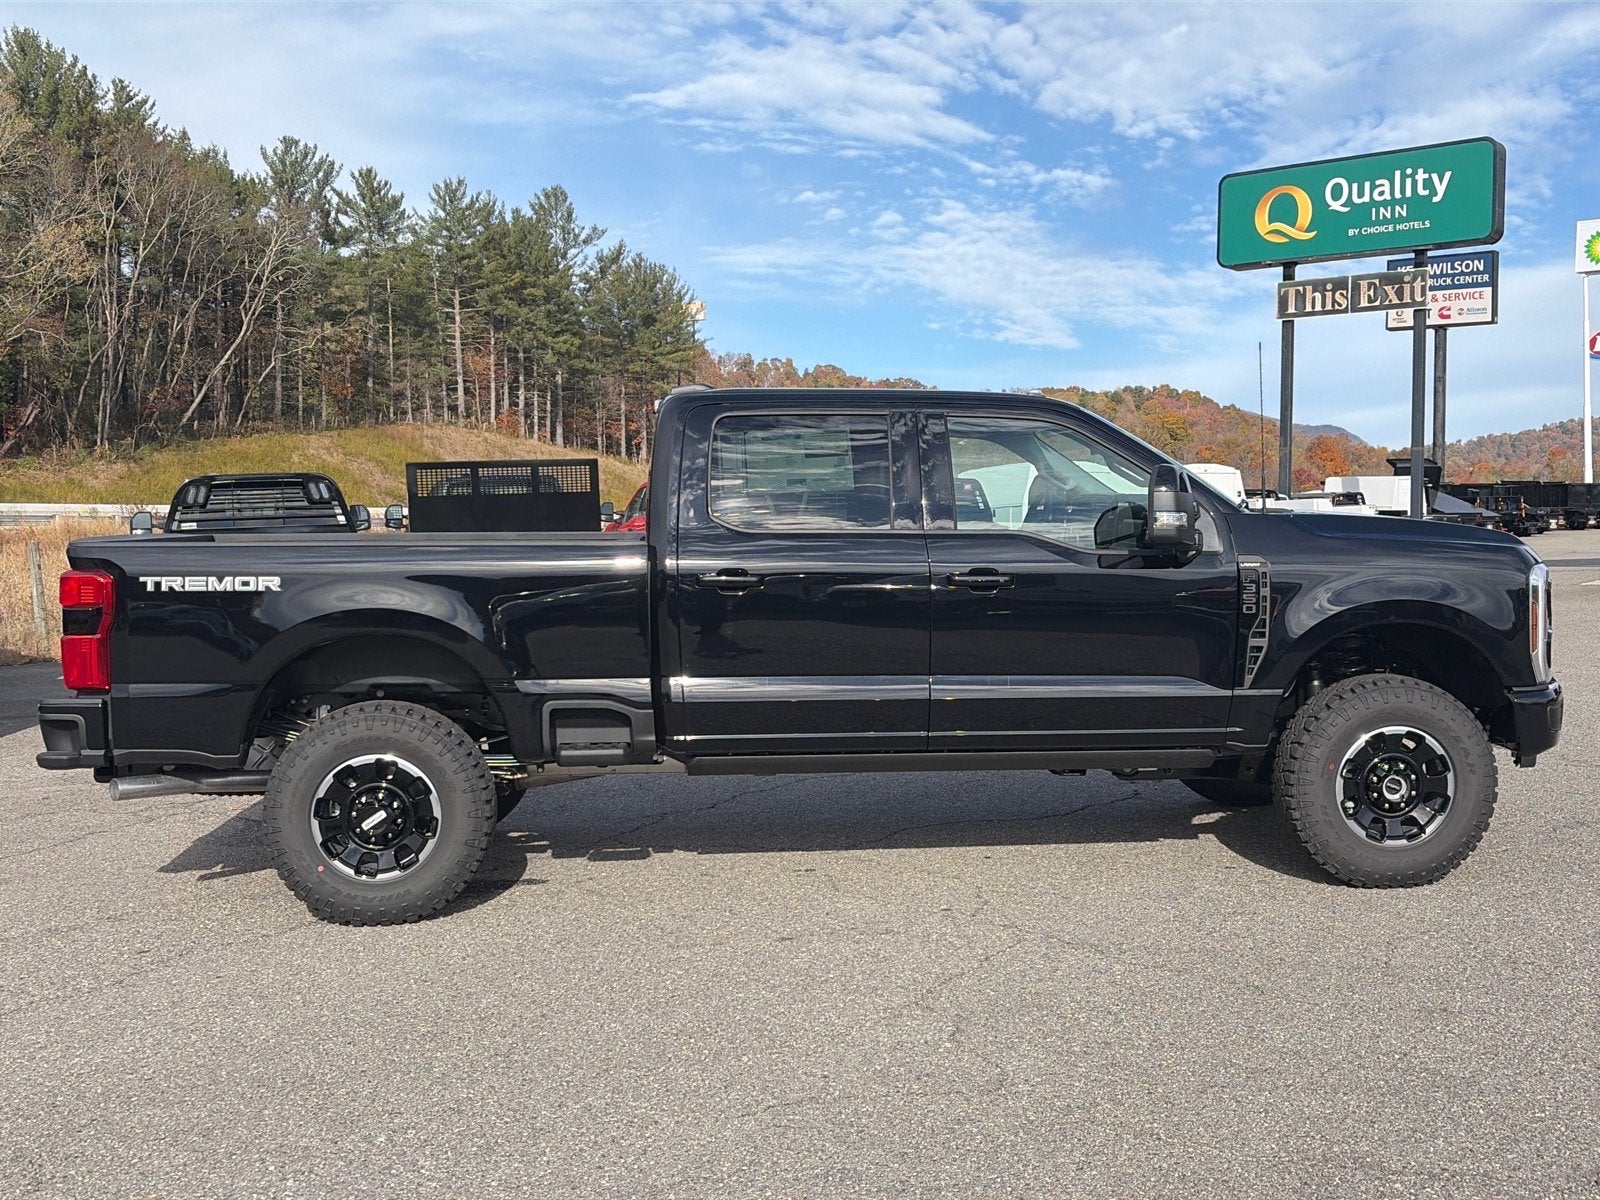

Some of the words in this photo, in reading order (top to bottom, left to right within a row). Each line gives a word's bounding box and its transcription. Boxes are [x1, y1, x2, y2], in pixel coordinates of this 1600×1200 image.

[1325, 168, 1452, 212] Quality
[1371, 204, 1407, 221] INN
[1348, 228, 1360, 236] BY
[1361, 224, 1394, 235] CHOICE
[1396, 220, 1431, 231] HOTELS
[1427, 259, 1484, 275] WILSON
[1428, 277, 1452, 287] RUCK
[1454, 274, 1490, 284] CENTER
[1280, 283, 1348, 314] This
[1357, 275, 1426, 308] Exit
[1430, 293, 1439, 303] &
[1442, 290, 1485, 302] SERVICE
[139, 576, 282, 592] TREMOR
